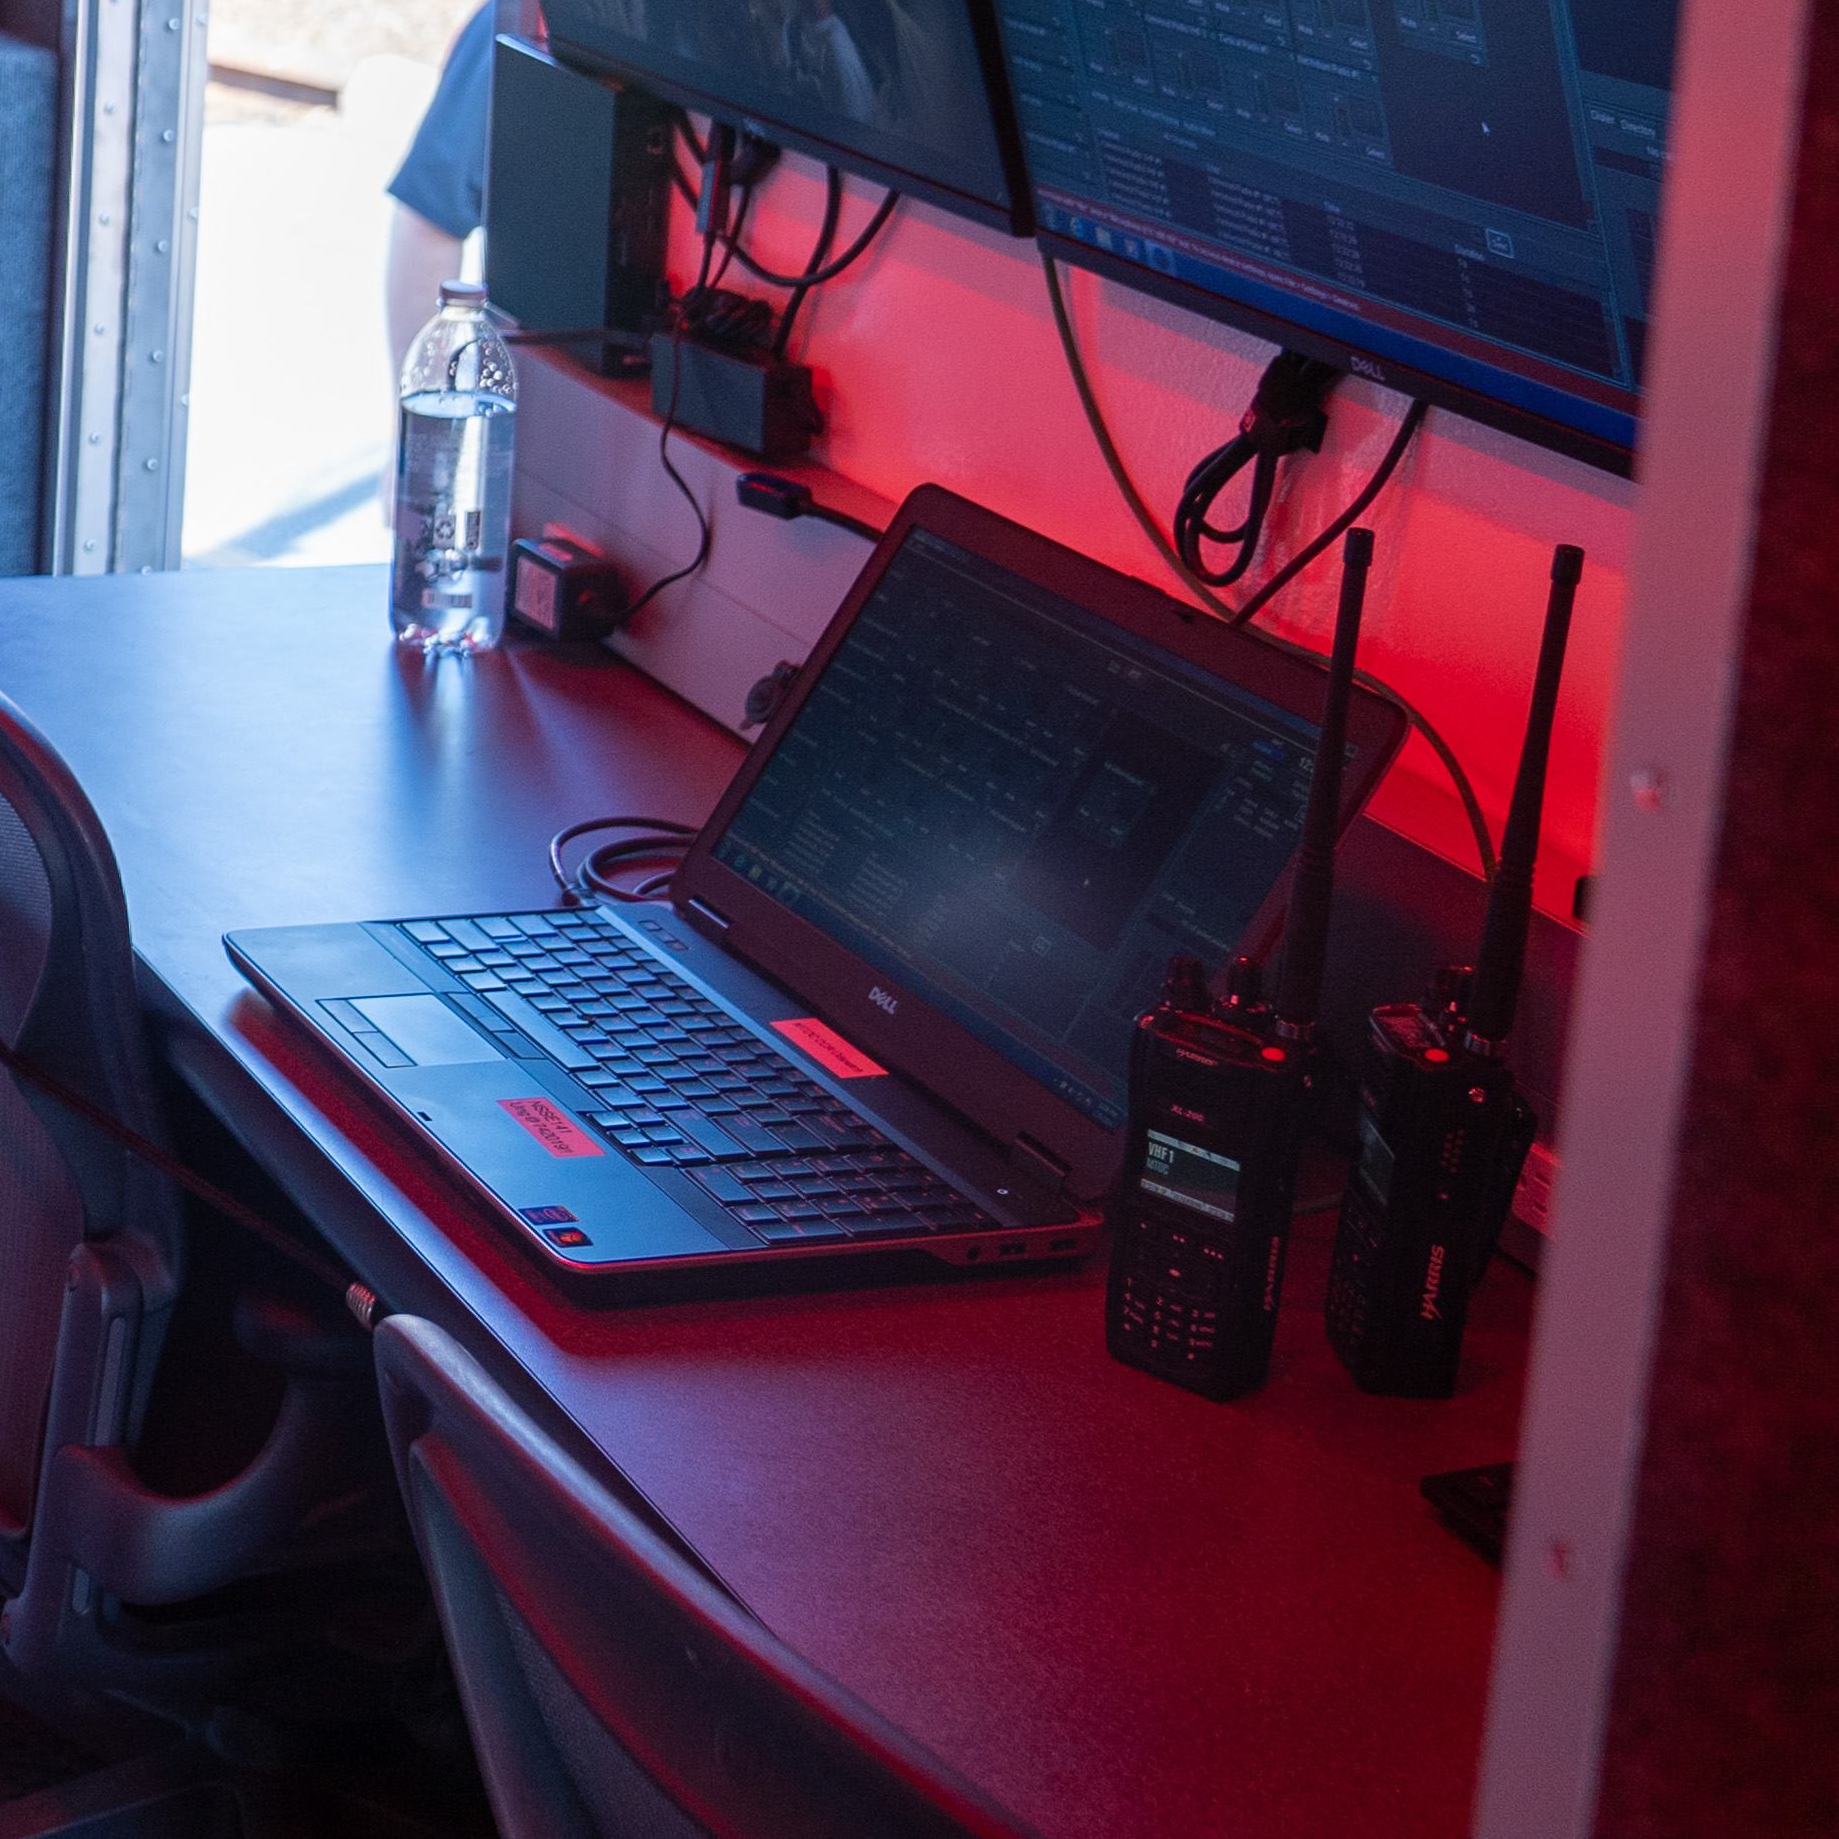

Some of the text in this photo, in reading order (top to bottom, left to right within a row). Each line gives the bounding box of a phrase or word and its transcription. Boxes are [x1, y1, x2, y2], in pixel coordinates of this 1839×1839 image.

[1349, 355, 1386, 381] DELL
[867, 985, 899, 1015] DELL
[1420, 1244, 1446, 1321] HARRIS
